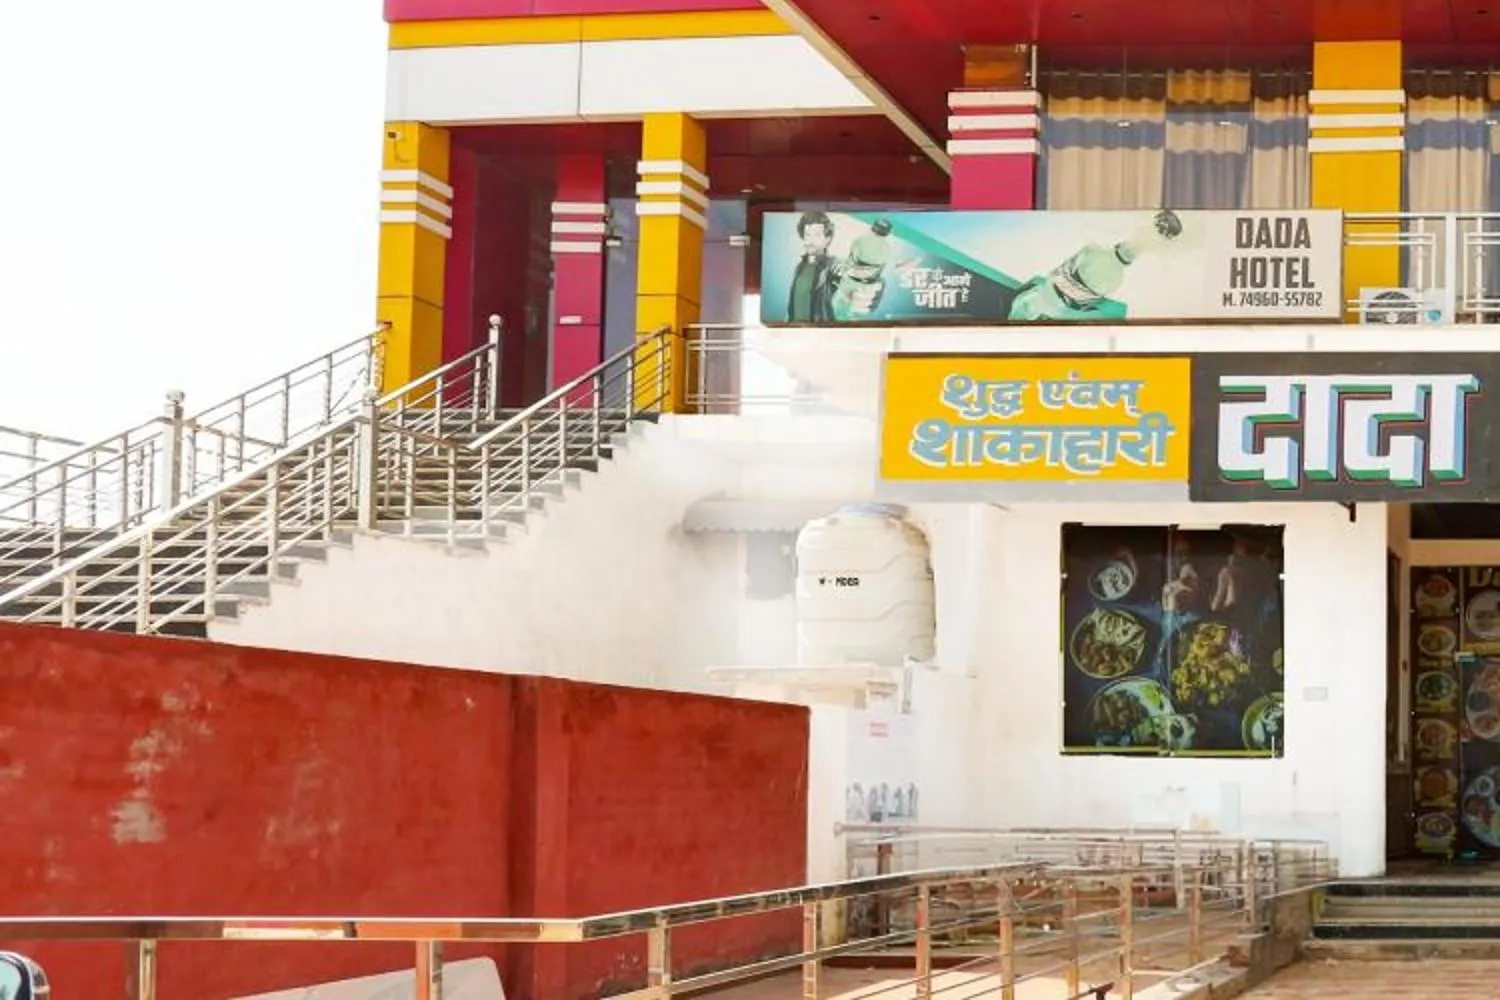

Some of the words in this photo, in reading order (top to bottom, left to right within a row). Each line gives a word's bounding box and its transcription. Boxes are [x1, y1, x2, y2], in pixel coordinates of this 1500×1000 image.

[1235, 217, 1312, 249] DADA
[1230, 257, 1315, 289] HOTEL
[909, 411, 1176, 475] शाकाहारी
[1217, 374, 1482, 489] दादा
